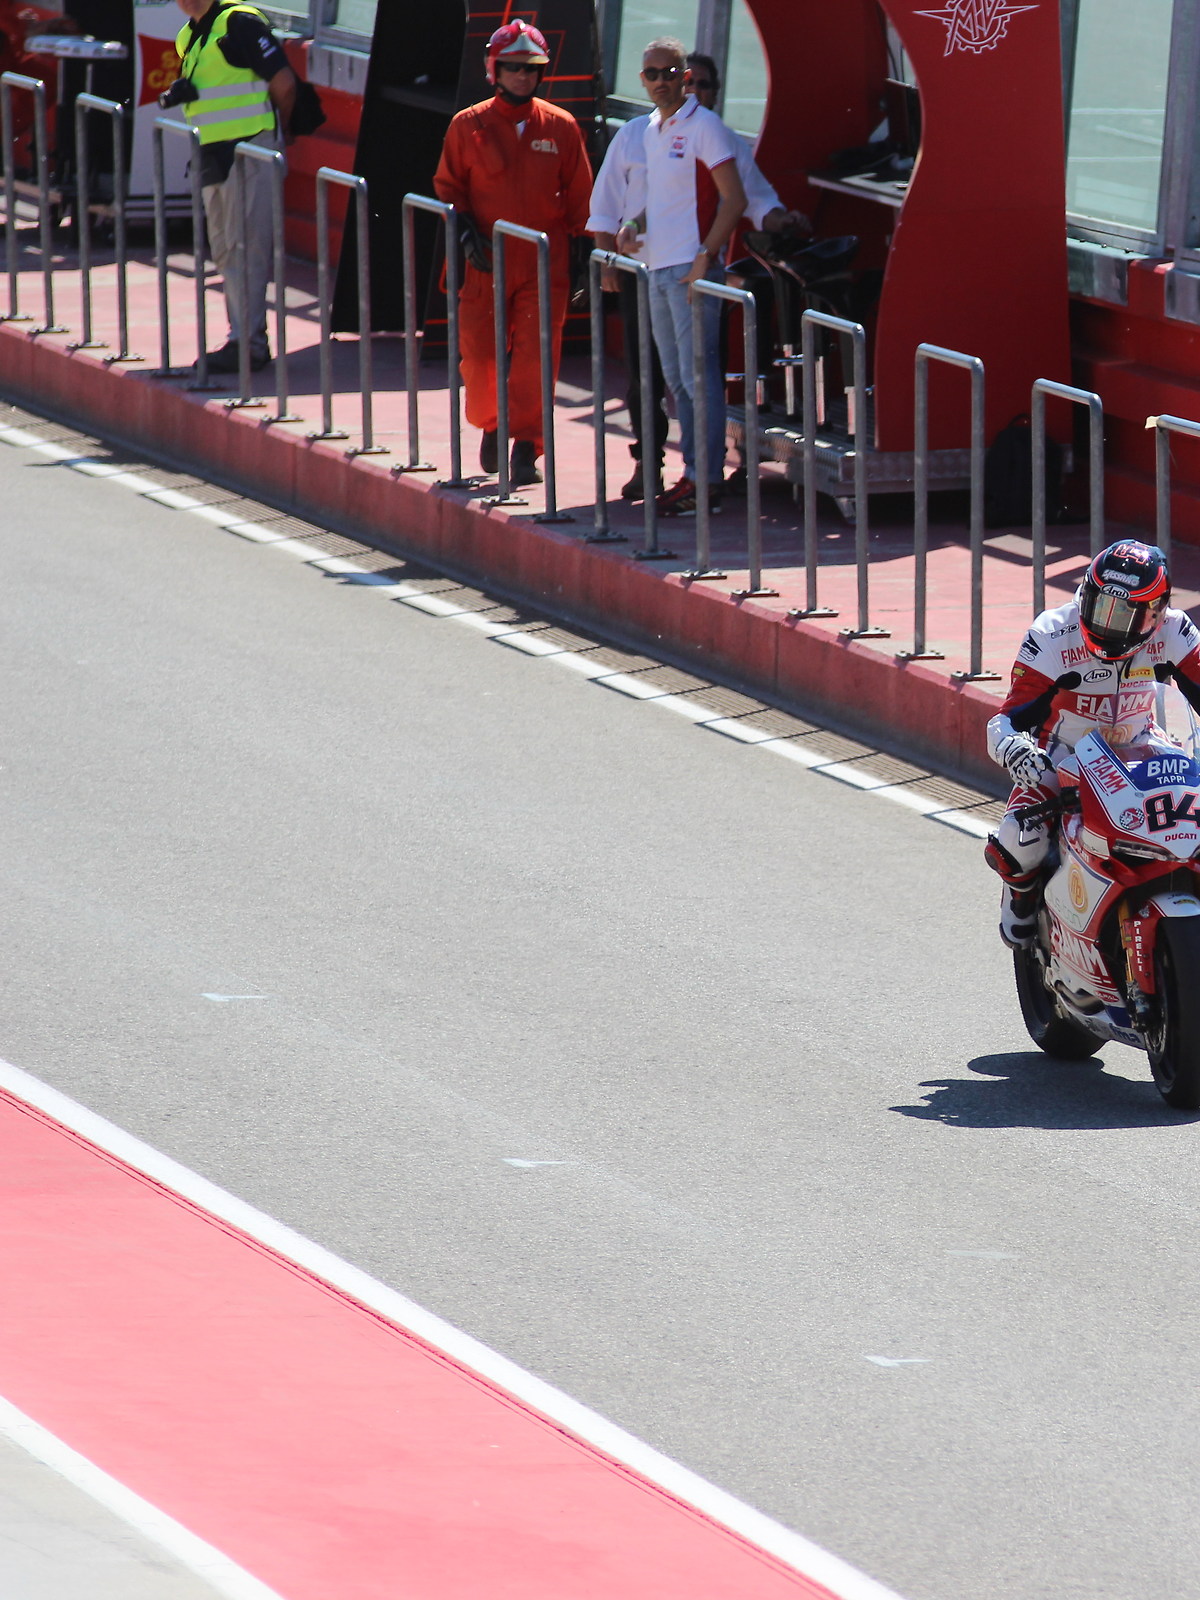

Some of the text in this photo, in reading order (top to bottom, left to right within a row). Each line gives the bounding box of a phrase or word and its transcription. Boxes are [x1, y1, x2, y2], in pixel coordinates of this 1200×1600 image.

[1084, 669, 1110, 682] Arai
[1076, 692, 1152, 717] FIAMM
[1088, 755, 1128, 794] FIAMM
[1147, 758, 1190, 777] BMP
[1157, 776, 1186, 785] TAPPI
[1164, 832, 1197, 842] DUCATI
[1133, 920, 1144, 972] PIRELLI
